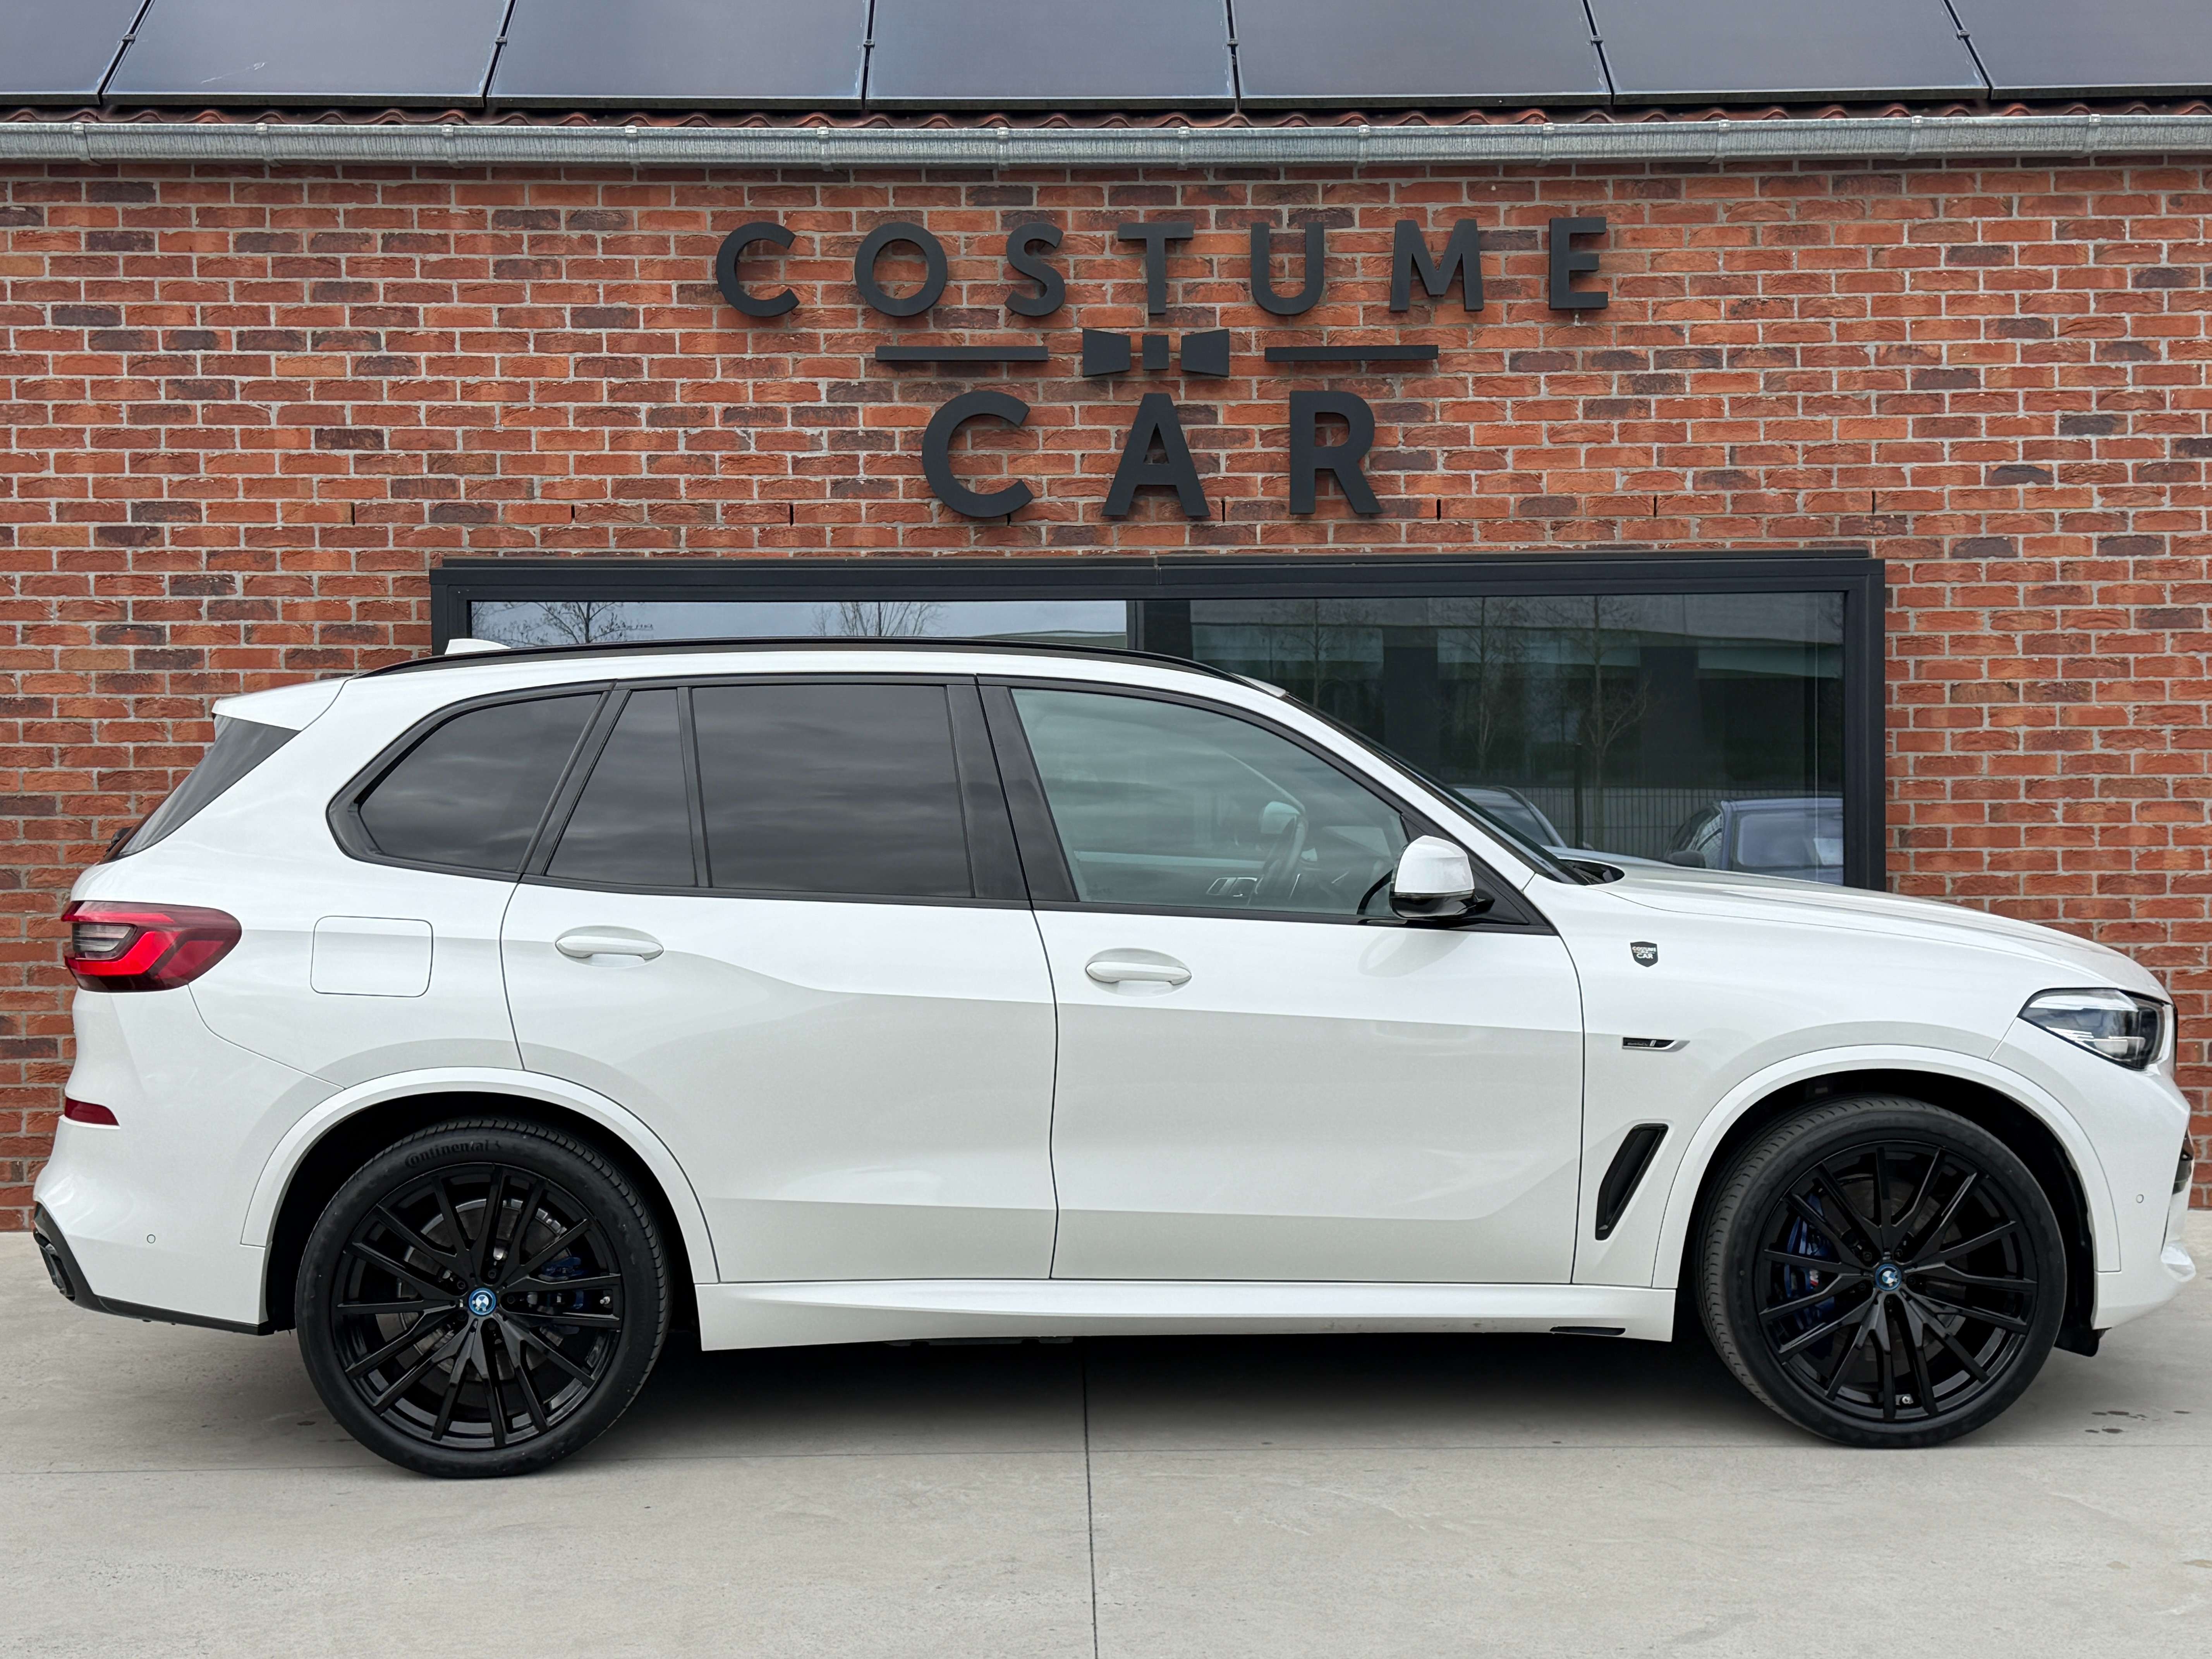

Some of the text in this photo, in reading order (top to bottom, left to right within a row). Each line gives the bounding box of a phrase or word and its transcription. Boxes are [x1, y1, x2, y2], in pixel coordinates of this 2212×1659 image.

[716, 218, 1608, 316] COSTUME
[923, 392, 1380, 517] CAR
[405, 1140, 489, 1167] Continental
